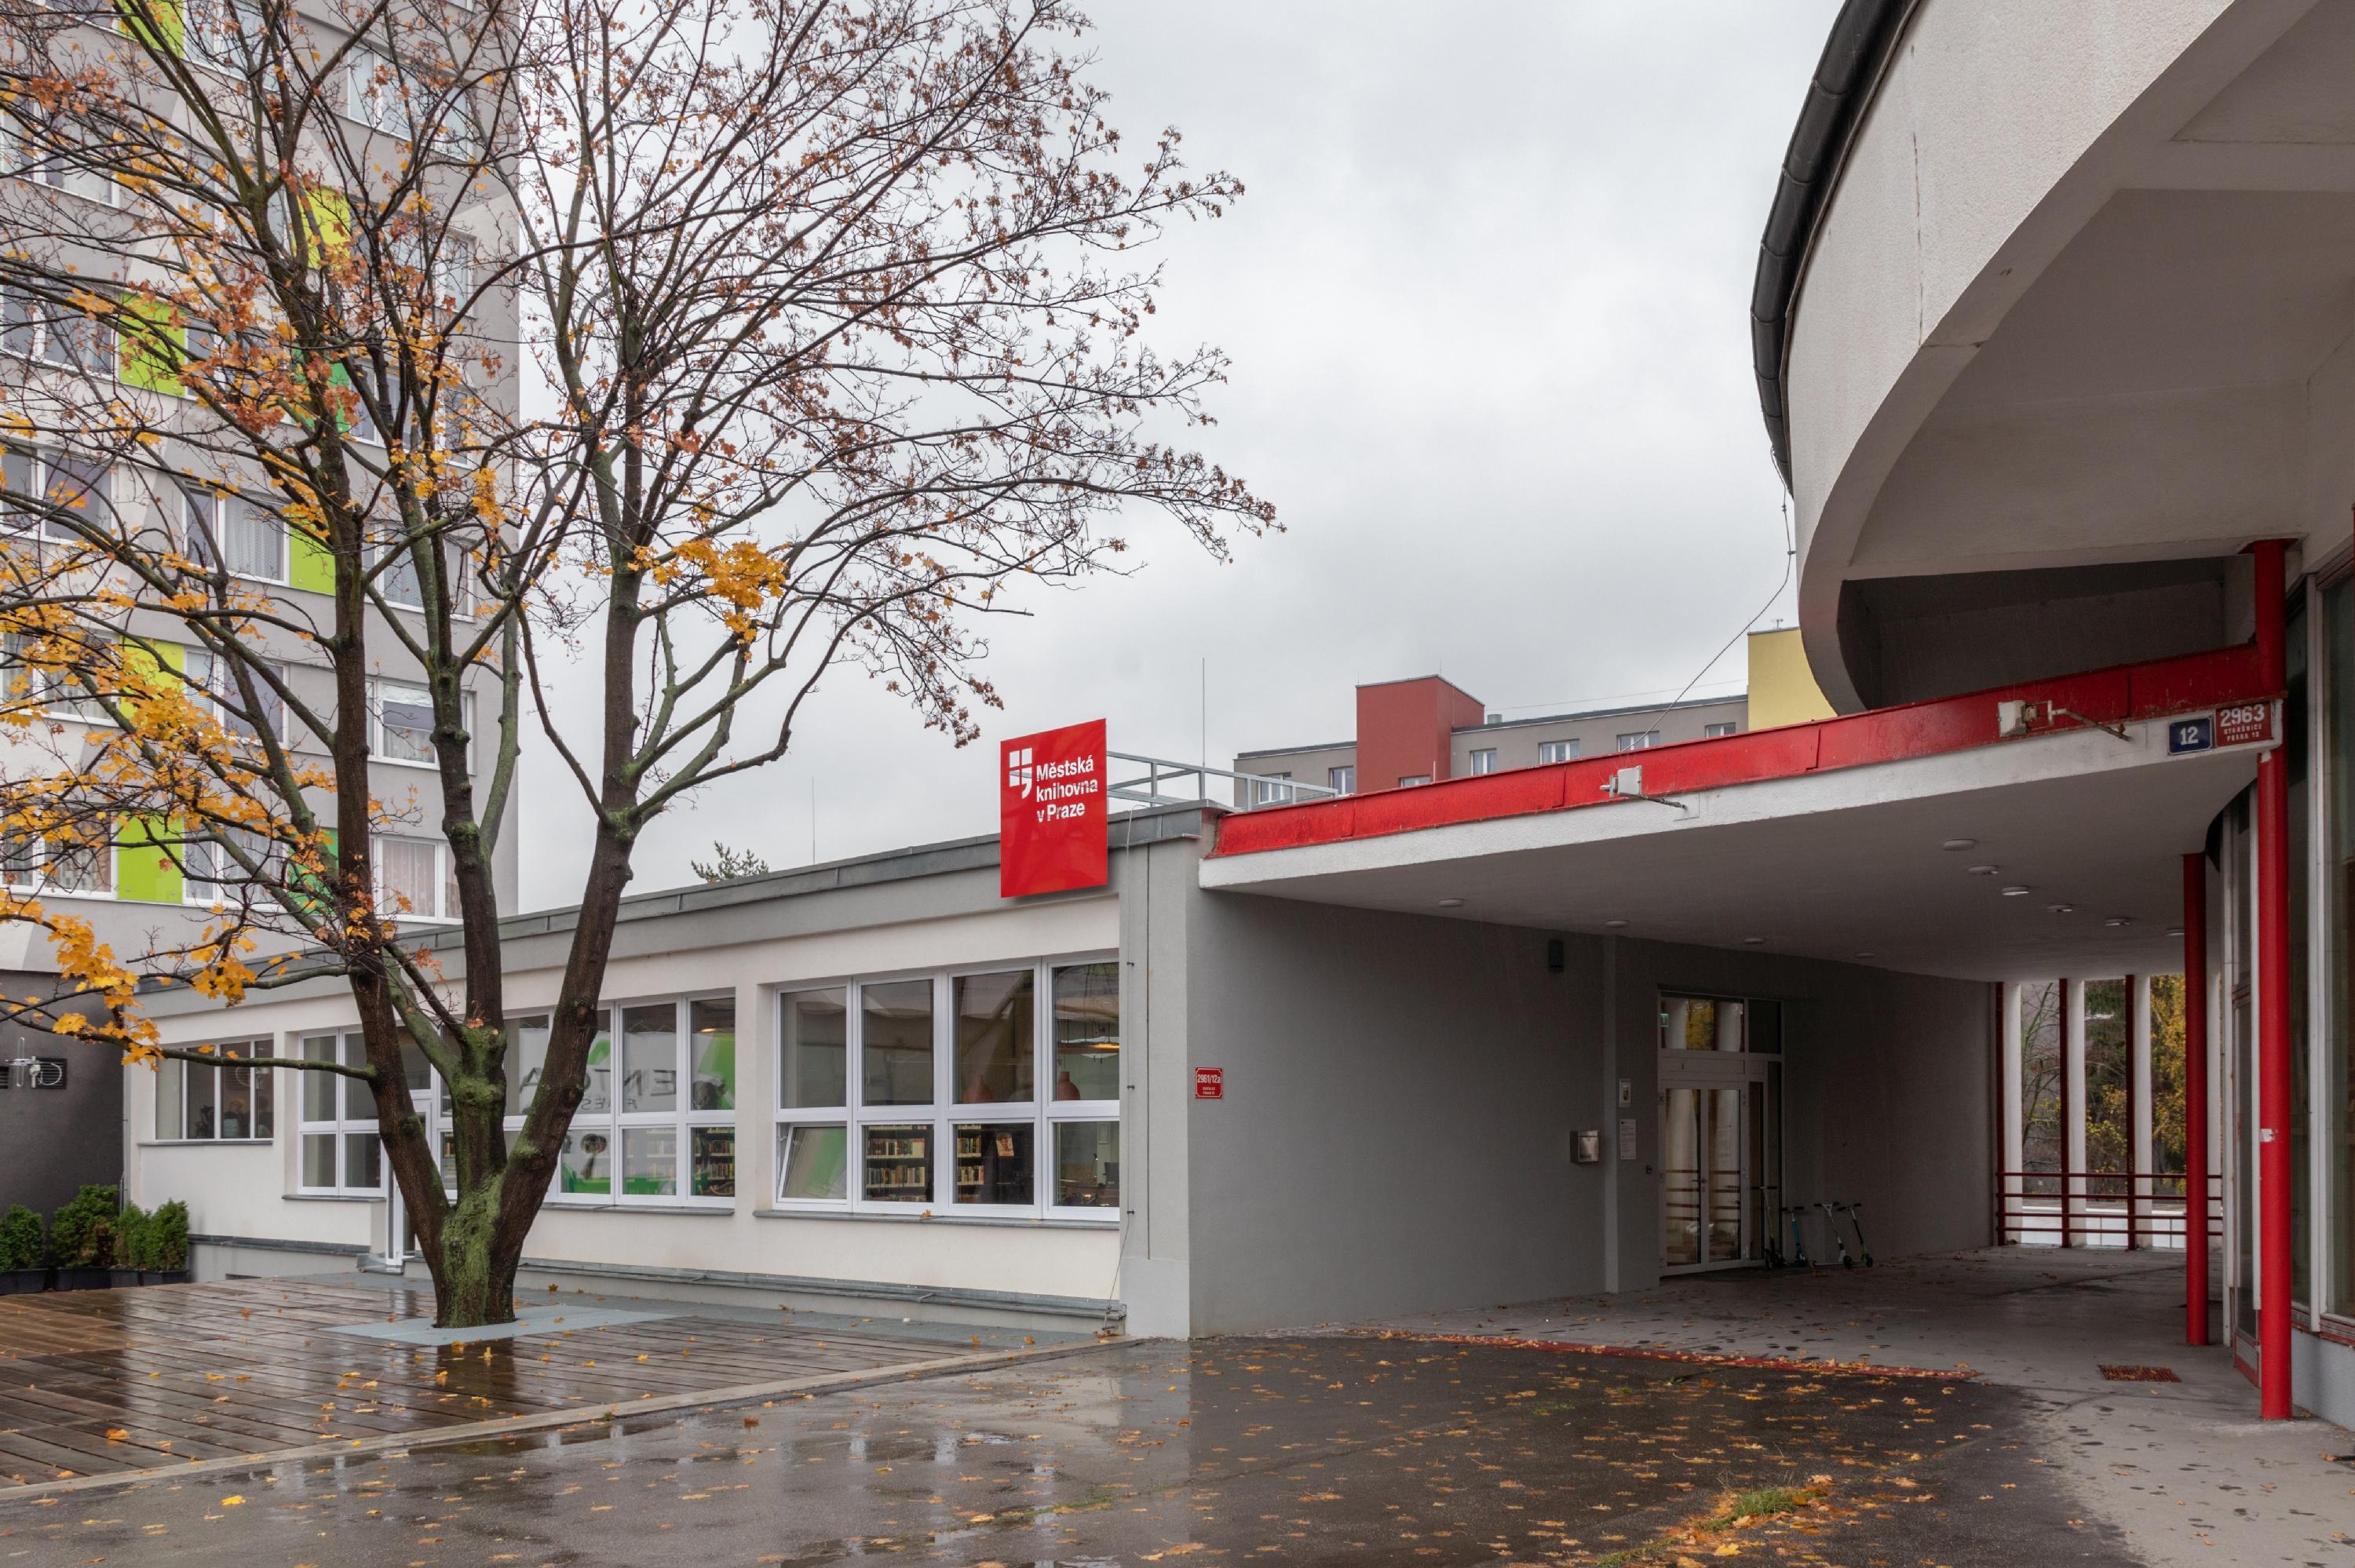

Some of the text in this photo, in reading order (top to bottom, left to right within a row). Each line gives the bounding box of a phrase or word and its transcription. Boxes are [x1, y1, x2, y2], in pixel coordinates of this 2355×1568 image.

[2220, 703, 2265, 727] 2963
[2180, 726, 2199, 746] 12
[1036, 755, 1094, 781] Městská
[1036, 779, 1098, 802] knihovna
[1037, 801, 1086, 822] v Praze
